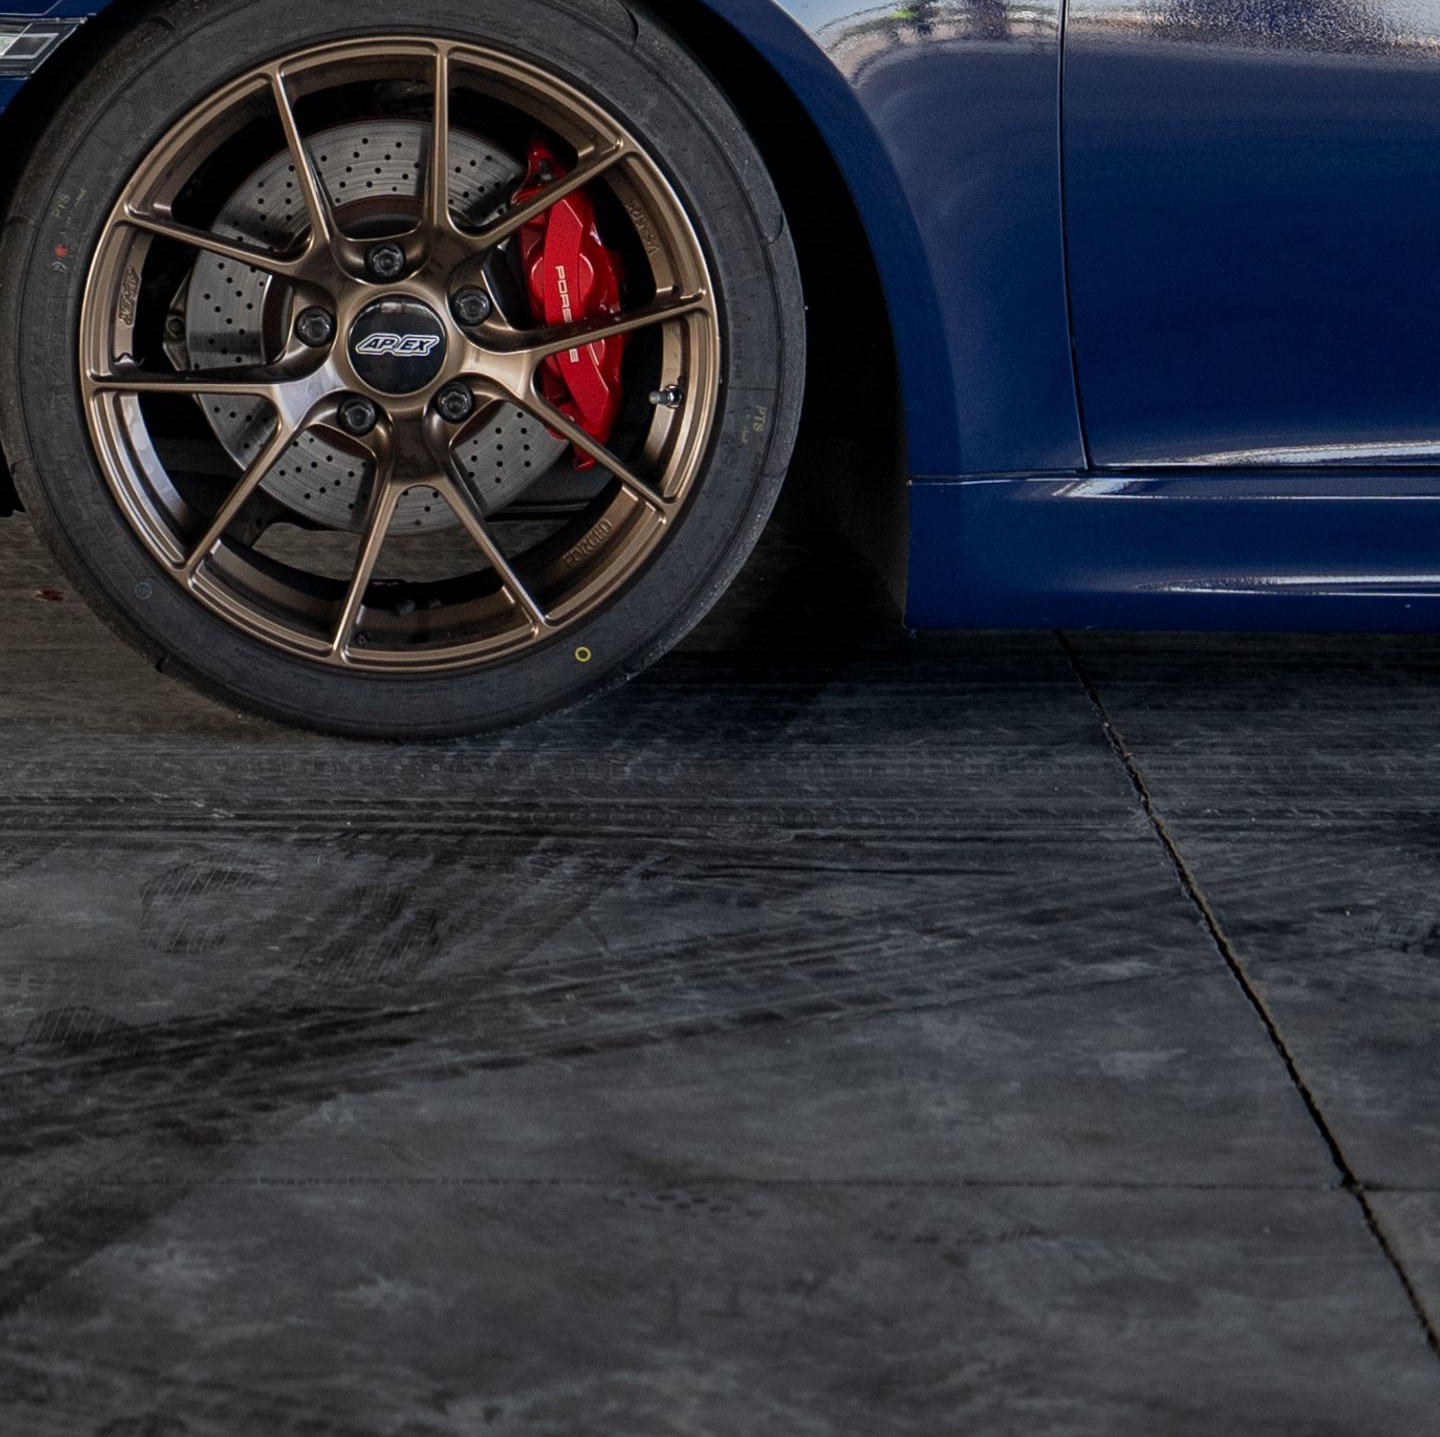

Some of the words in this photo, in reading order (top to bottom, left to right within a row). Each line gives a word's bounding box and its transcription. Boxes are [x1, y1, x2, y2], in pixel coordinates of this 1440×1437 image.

[555, 265, 580, 363] PORSE
[359, 335, 436, 354] APEX
[561, 517, 614, 569] FORGED
